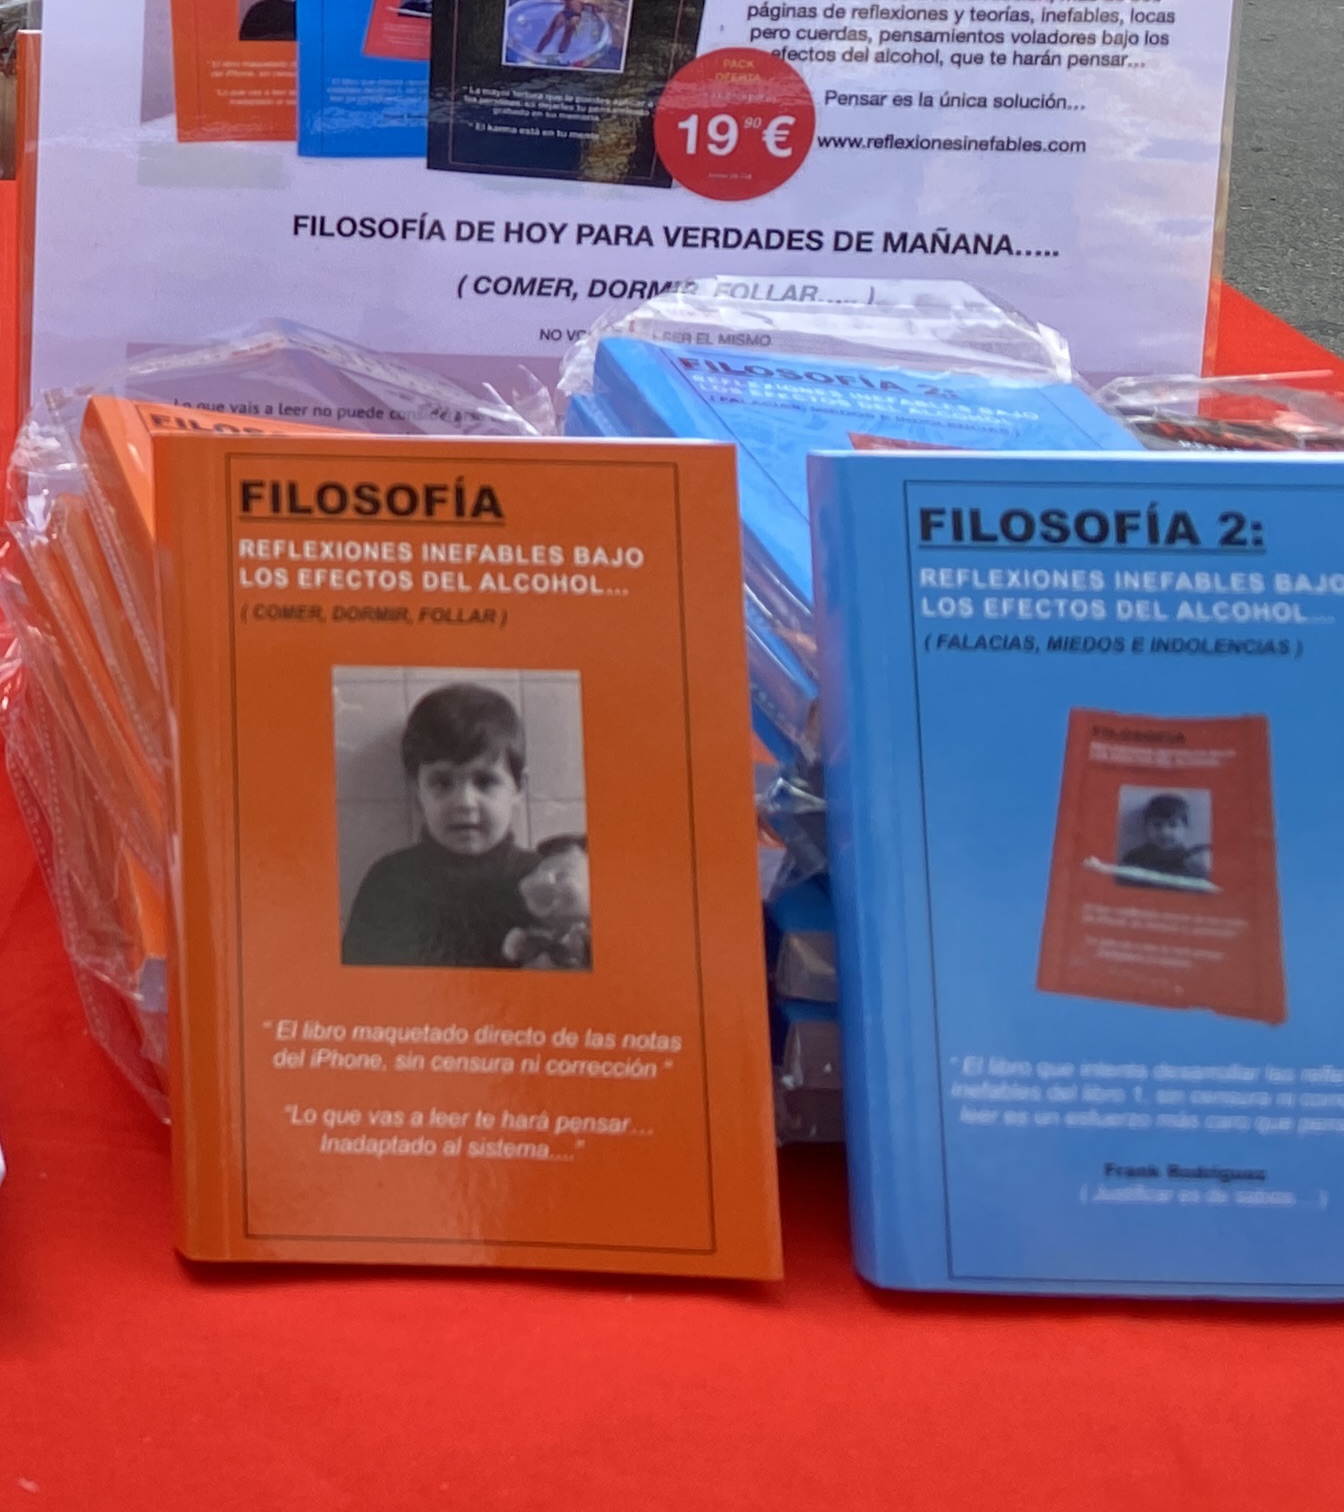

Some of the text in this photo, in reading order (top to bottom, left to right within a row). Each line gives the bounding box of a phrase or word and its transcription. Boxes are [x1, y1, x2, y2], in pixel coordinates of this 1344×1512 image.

[747, 2, 1175, 26] páginas de reflexiones y teorías, inefables, locas
[750, 26, 1169, 50] pero cuerdas, pensamientos voladores bajo los
[842, 46, 869, 63] del
[874, 48, 943, 67] alcohol,
[950, 53, 984, 68] que
[990, 51, 1007, 66] te
[1013, 49, 1061, 66] harán
[825, 89, 887, 107] Pensar
[892, 94, 912, 107] es
[919, 91, 933, 108] la
[940, 91, 987, 108] única
[817, 134, 1086, 153] www.reflexionesinefables.com
[294, 212, 446, 241] FILOSOFÍA
[456, 219, 495, 242] DE
[504, 222, 567, 245] HOY
[577, 223, 653, 247] PARA
[663, 225, 823, 252] VERDADES
[834, 230, 873, 253] DE
[474, 275, 577, 301] COMER,
[539, 328, 562, 341] NO
[230, 402, 384, 421] vais a leer no puede
[241, 477, 505, 518] FILOSOFÍA
[920, 505, 1263, 548] FILOSOFÍA 2:
[239, 539, 644, 568] REFLEXIONES INEFABLES BAJO
[240, 567, 288, 588] LOS
[298, 568, 413, 591] EFECTOS
[423, 570, 470, 592] DEL
[920, 568, 1104, 592] REFLEXIONES
[1115, 571, 1264, 594] INEFABLES
[922, 596, 973, 618] LOS
[984, 597, 1106, 620] EFECTOS
[1117, 599, 1167, 621] DEL
[937, 633, 1290, 656] FALACIAS, MIEDOS E INDOLENCIAS
[276, 1019, 682, 1052] El libro maquetado directo de las notas
[273, 1048, 305, 1069] del
[395, 1054, 425, 1071] sin
[430, 1055, 514, 1074] censura
[520, 1054, 540, 1073] ni
[545, 1058, 657, 1080] corrección
